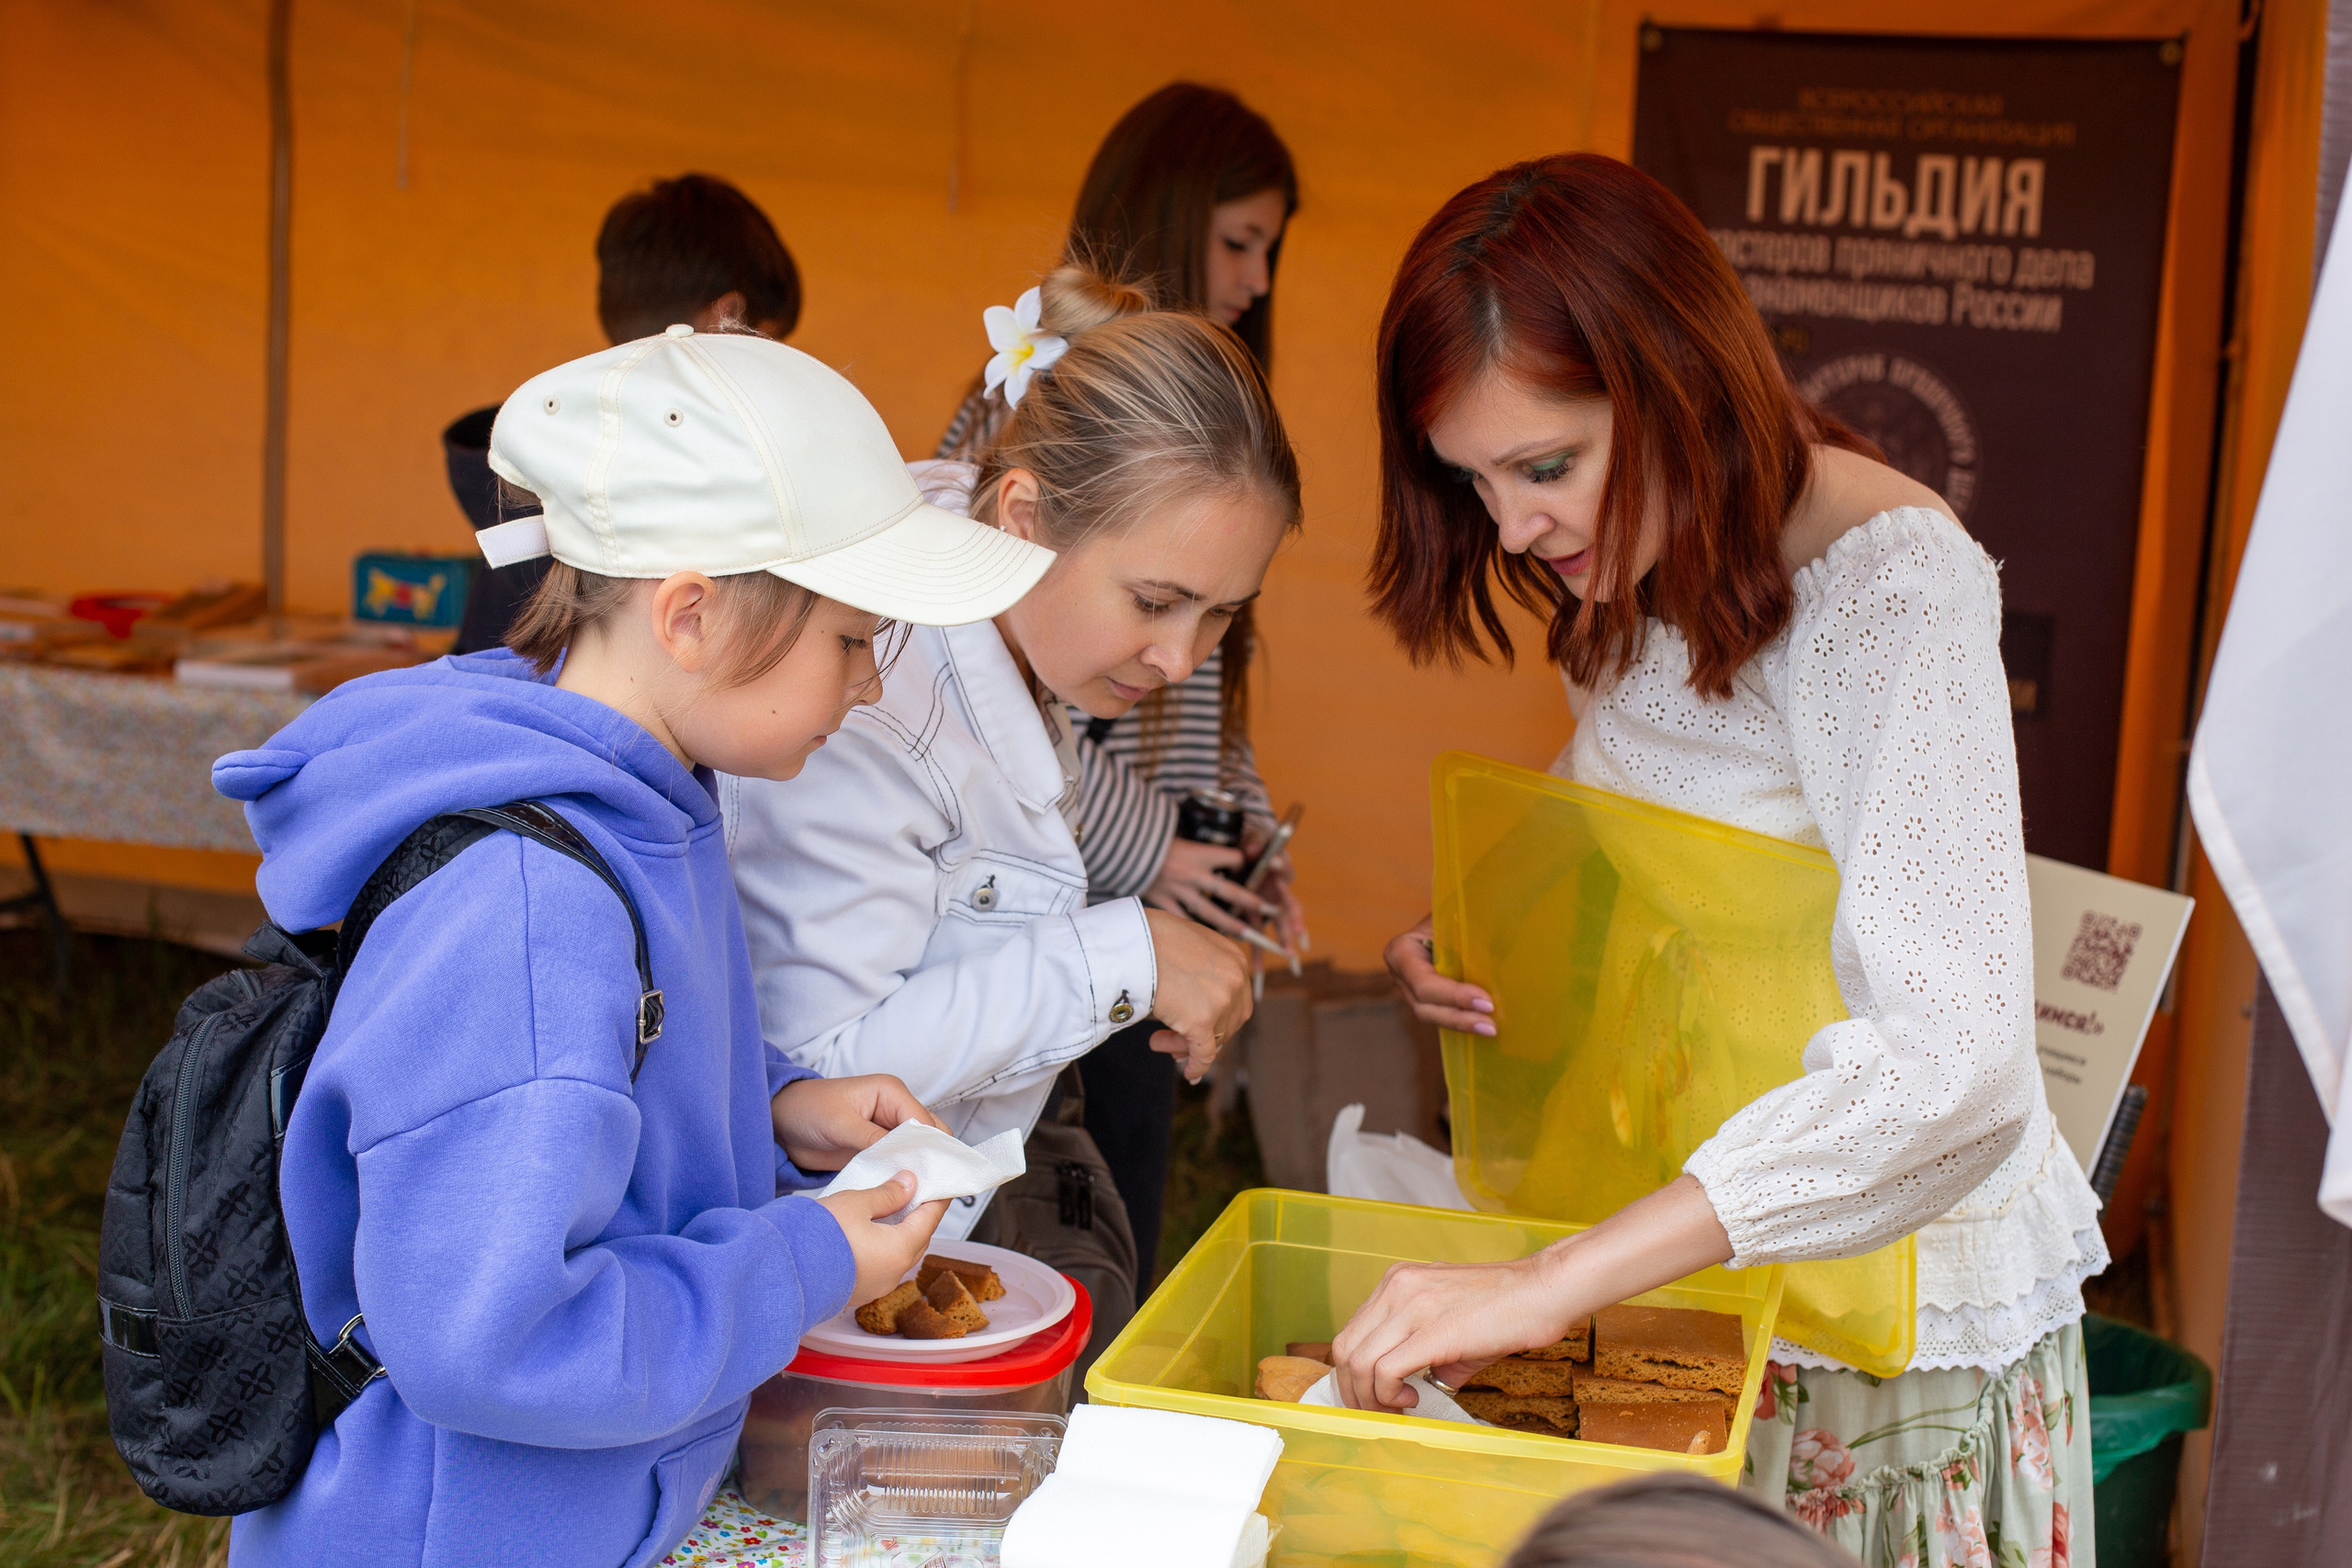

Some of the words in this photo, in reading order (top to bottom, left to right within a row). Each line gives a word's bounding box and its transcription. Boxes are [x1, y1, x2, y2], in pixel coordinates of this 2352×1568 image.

[1747, 145, 2045, 240] ГИЛЬДИЯ
[1834, 236, 2012, 286] пряничного
[2013, 247, 2095, 290] дела
[1951, 279, 2064, 333] России
